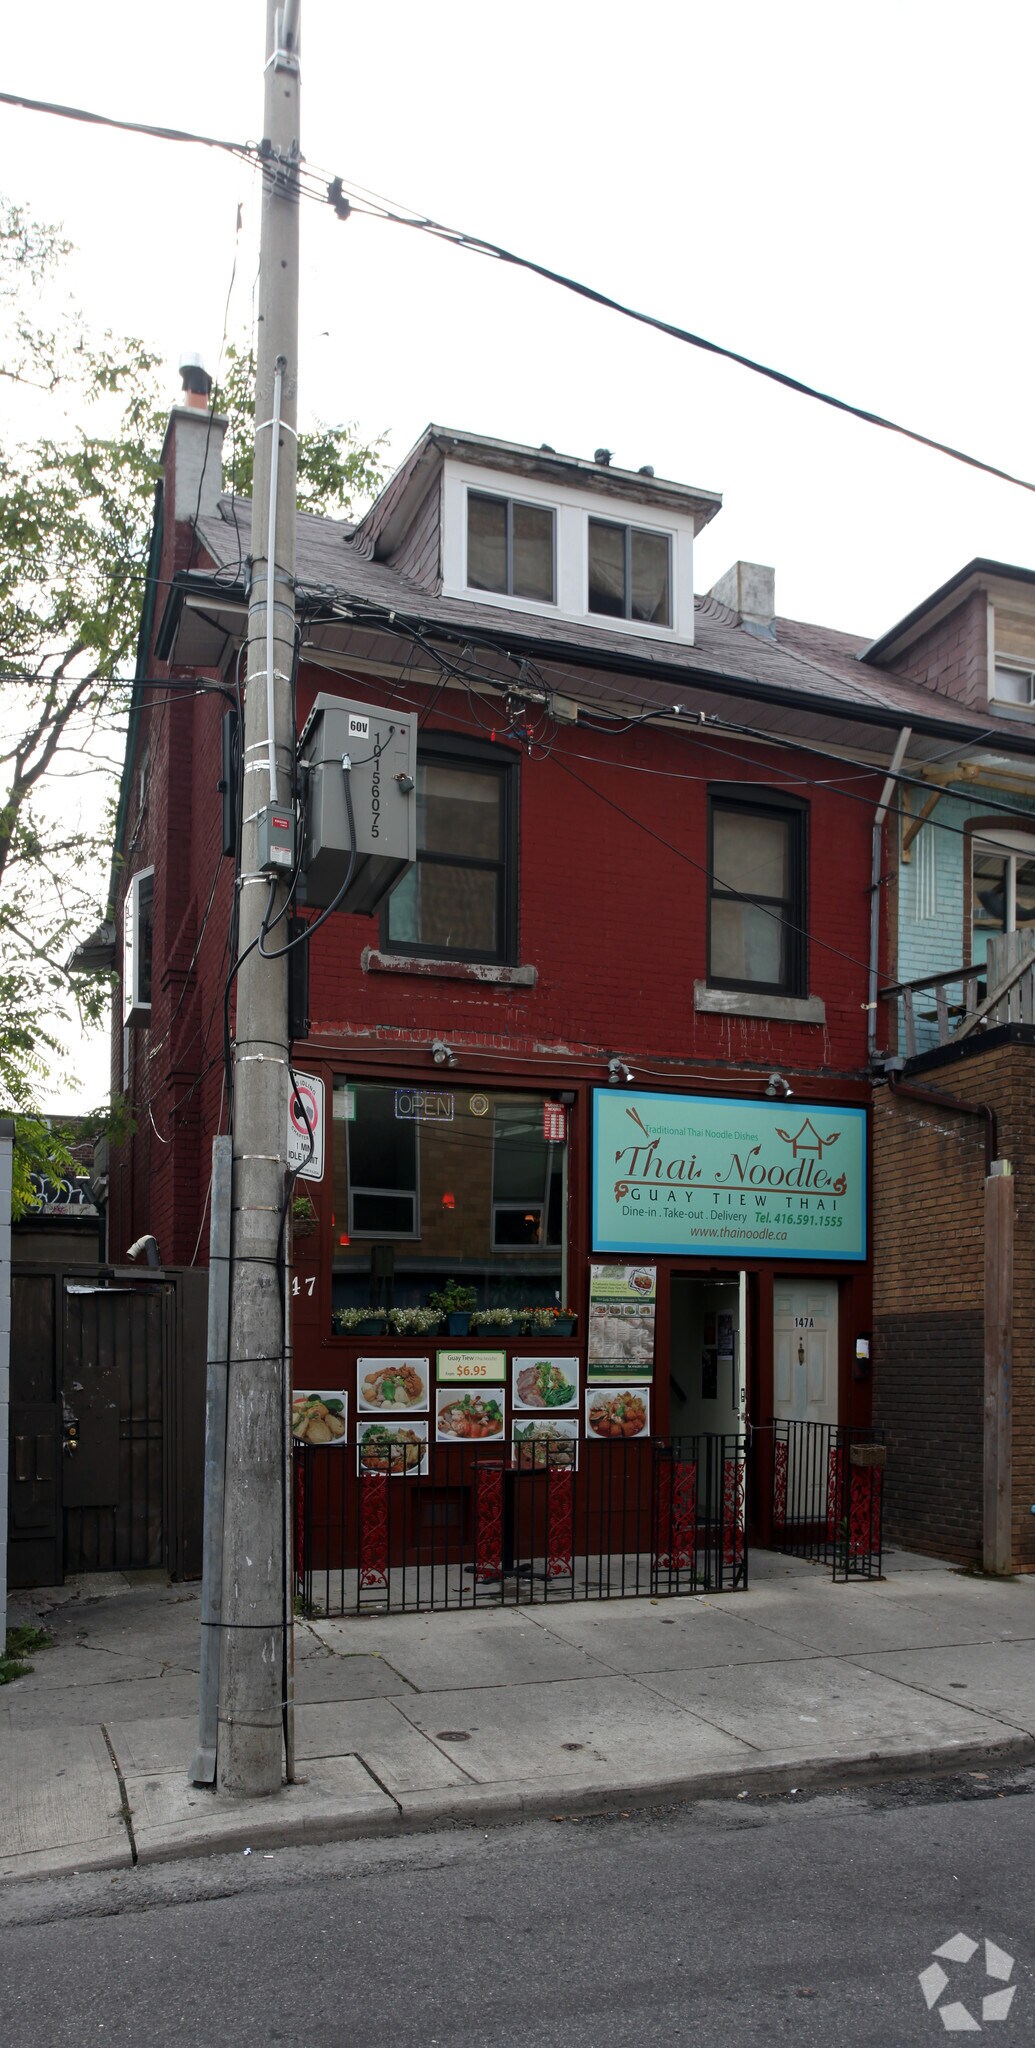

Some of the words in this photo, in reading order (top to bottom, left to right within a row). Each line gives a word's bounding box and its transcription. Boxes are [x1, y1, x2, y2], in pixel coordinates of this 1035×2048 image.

[350, 720, 368, 733] 60V
[371, 732, 382, 838] 10156075
[300, 1080, 316, 1096] IDLING
[399, 1095, 450, 1116] OPEN
[645, 1125, 686, 1136] Traditional
[687, 1128, 704, 1137] Thai
[705, 1129, 733, 1140] Noodle
[734, 1131, 759, 1141] Dishes
[288, 1150, 302, 1161] IDLE
[615, 1137, 702, 1180] Thai
[714, 1144, 832, 1188] Noodle
[631, 1188, 693, 1203] GUAY
[713, 1192, 767, 1207] TIEW
[786, 1197, 836, 1211] THAI
[710, 1209, 747, 1224] Delivery
[755, 1212, 772, 1224] Tel.
[774, 1213, 843, 1228] 416.591.1555
[690, 1226, 788, 1241] www.thainoodle.ca
[795, 1317, 814, 1328] 147A
[447, 1354, 461, 1362] Guay
[456, 1365, 487, 1377] $6.95
